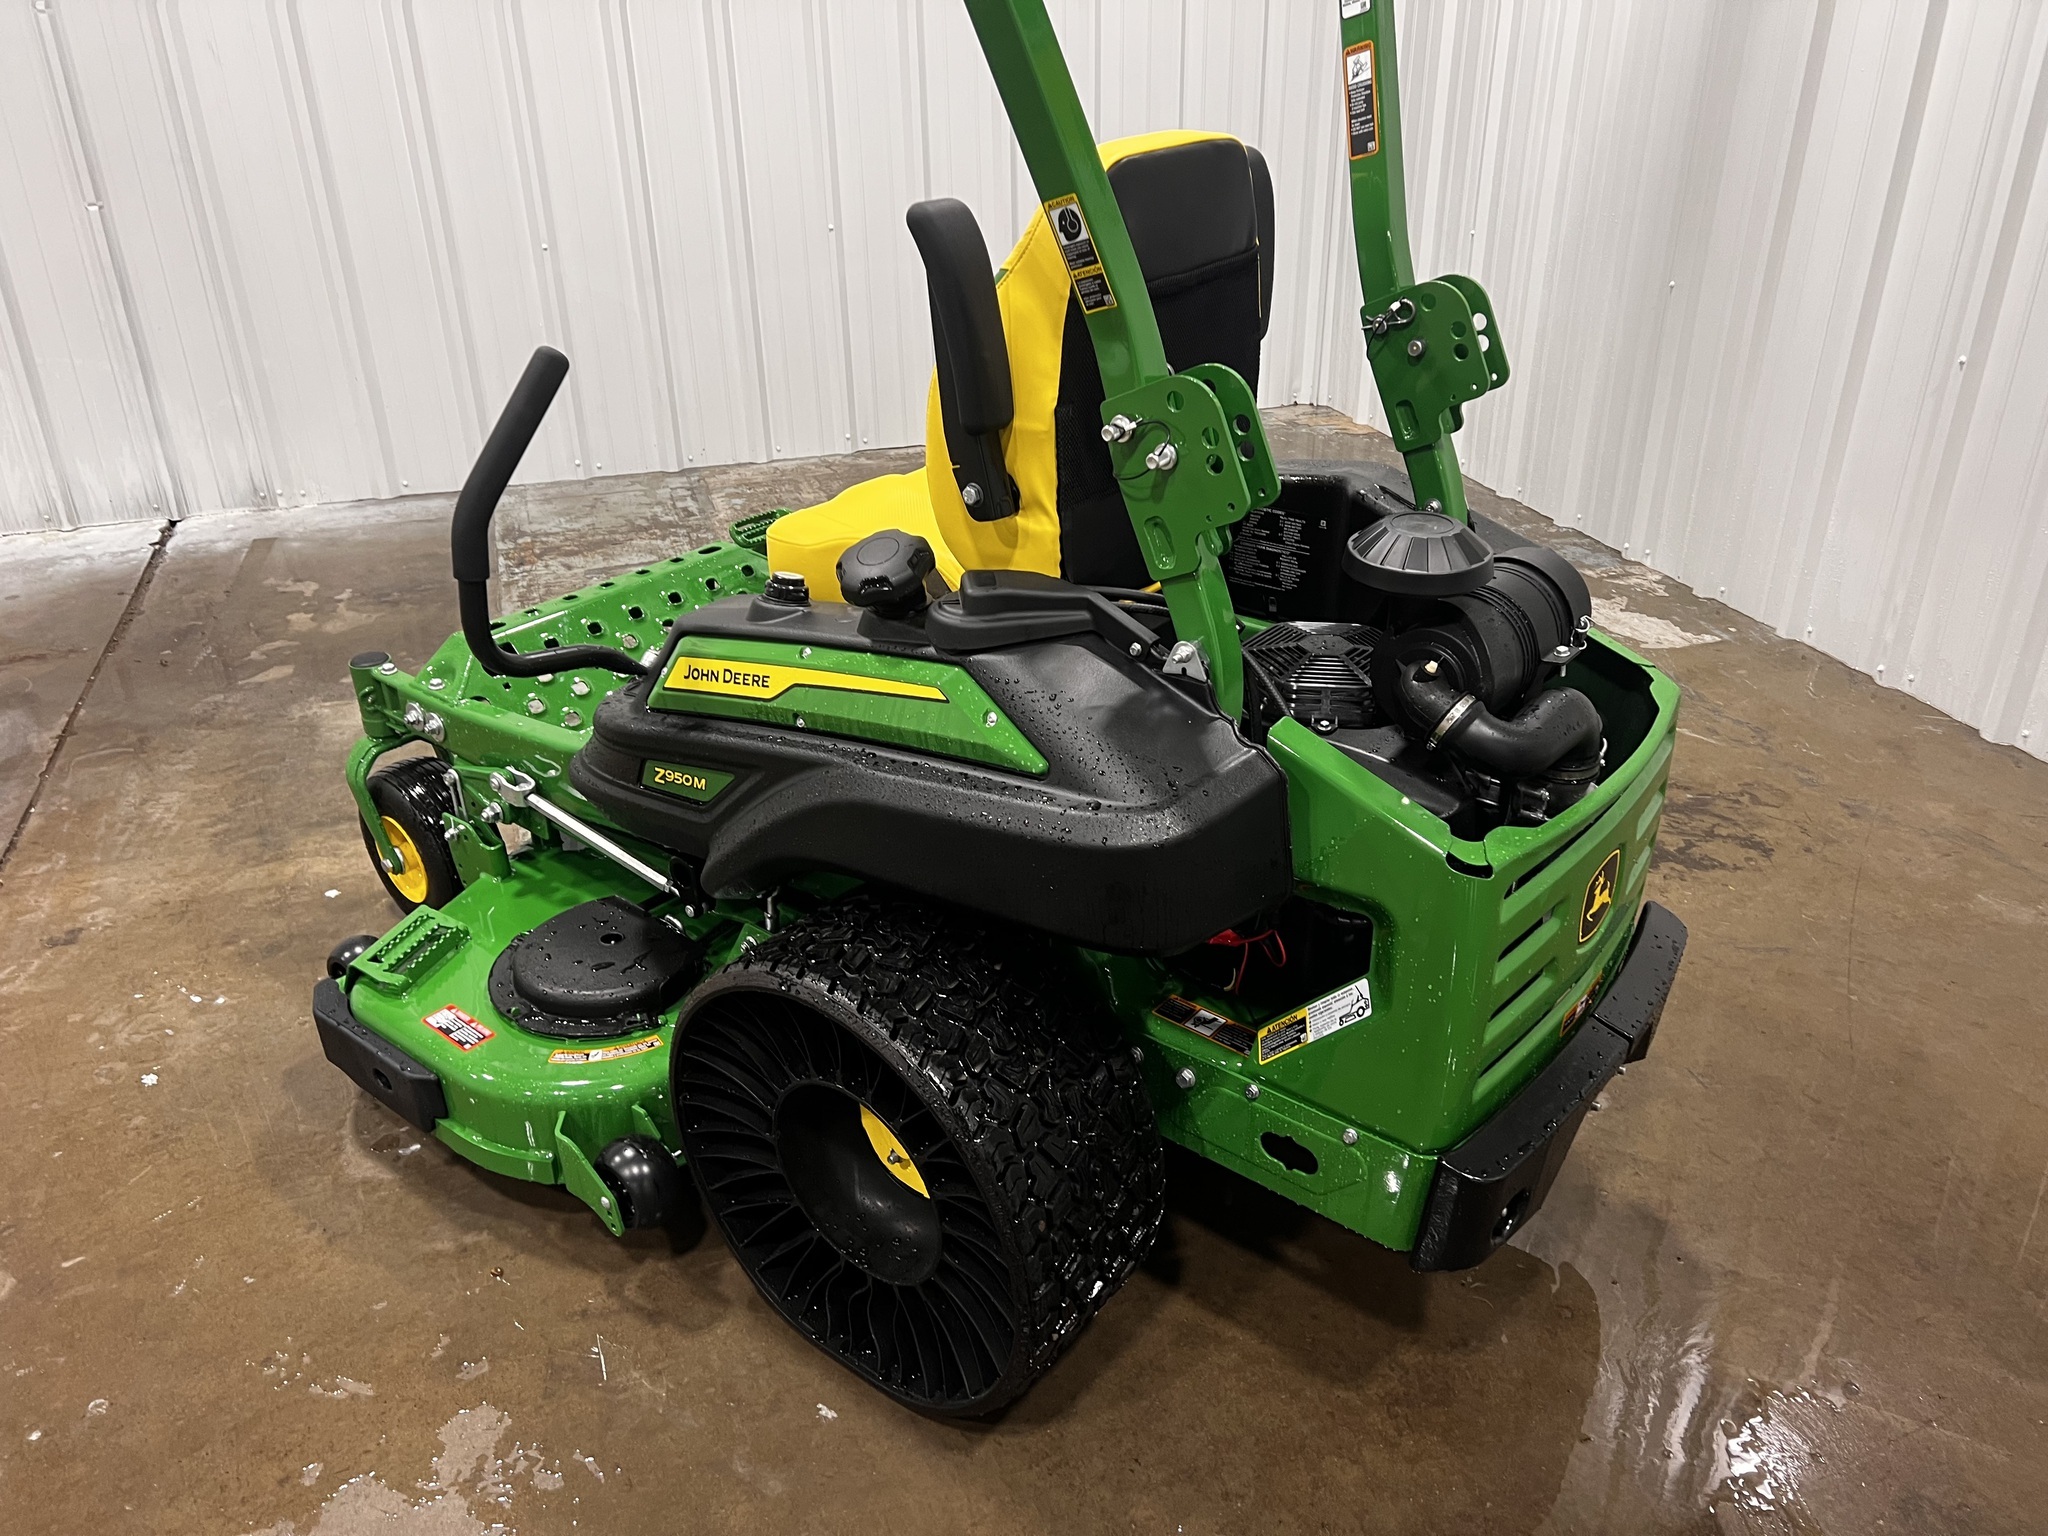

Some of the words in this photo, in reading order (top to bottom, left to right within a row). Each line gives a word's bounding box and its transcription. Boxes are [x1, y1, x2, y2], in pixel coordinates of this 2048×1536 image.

[683, 664, 720, 683] JOHN
[722, 668, 771, 688] DEERE
[654, 766, 706, 791] Z950M
[1271, 1013, 1298, 1032] ATENCIÓN
